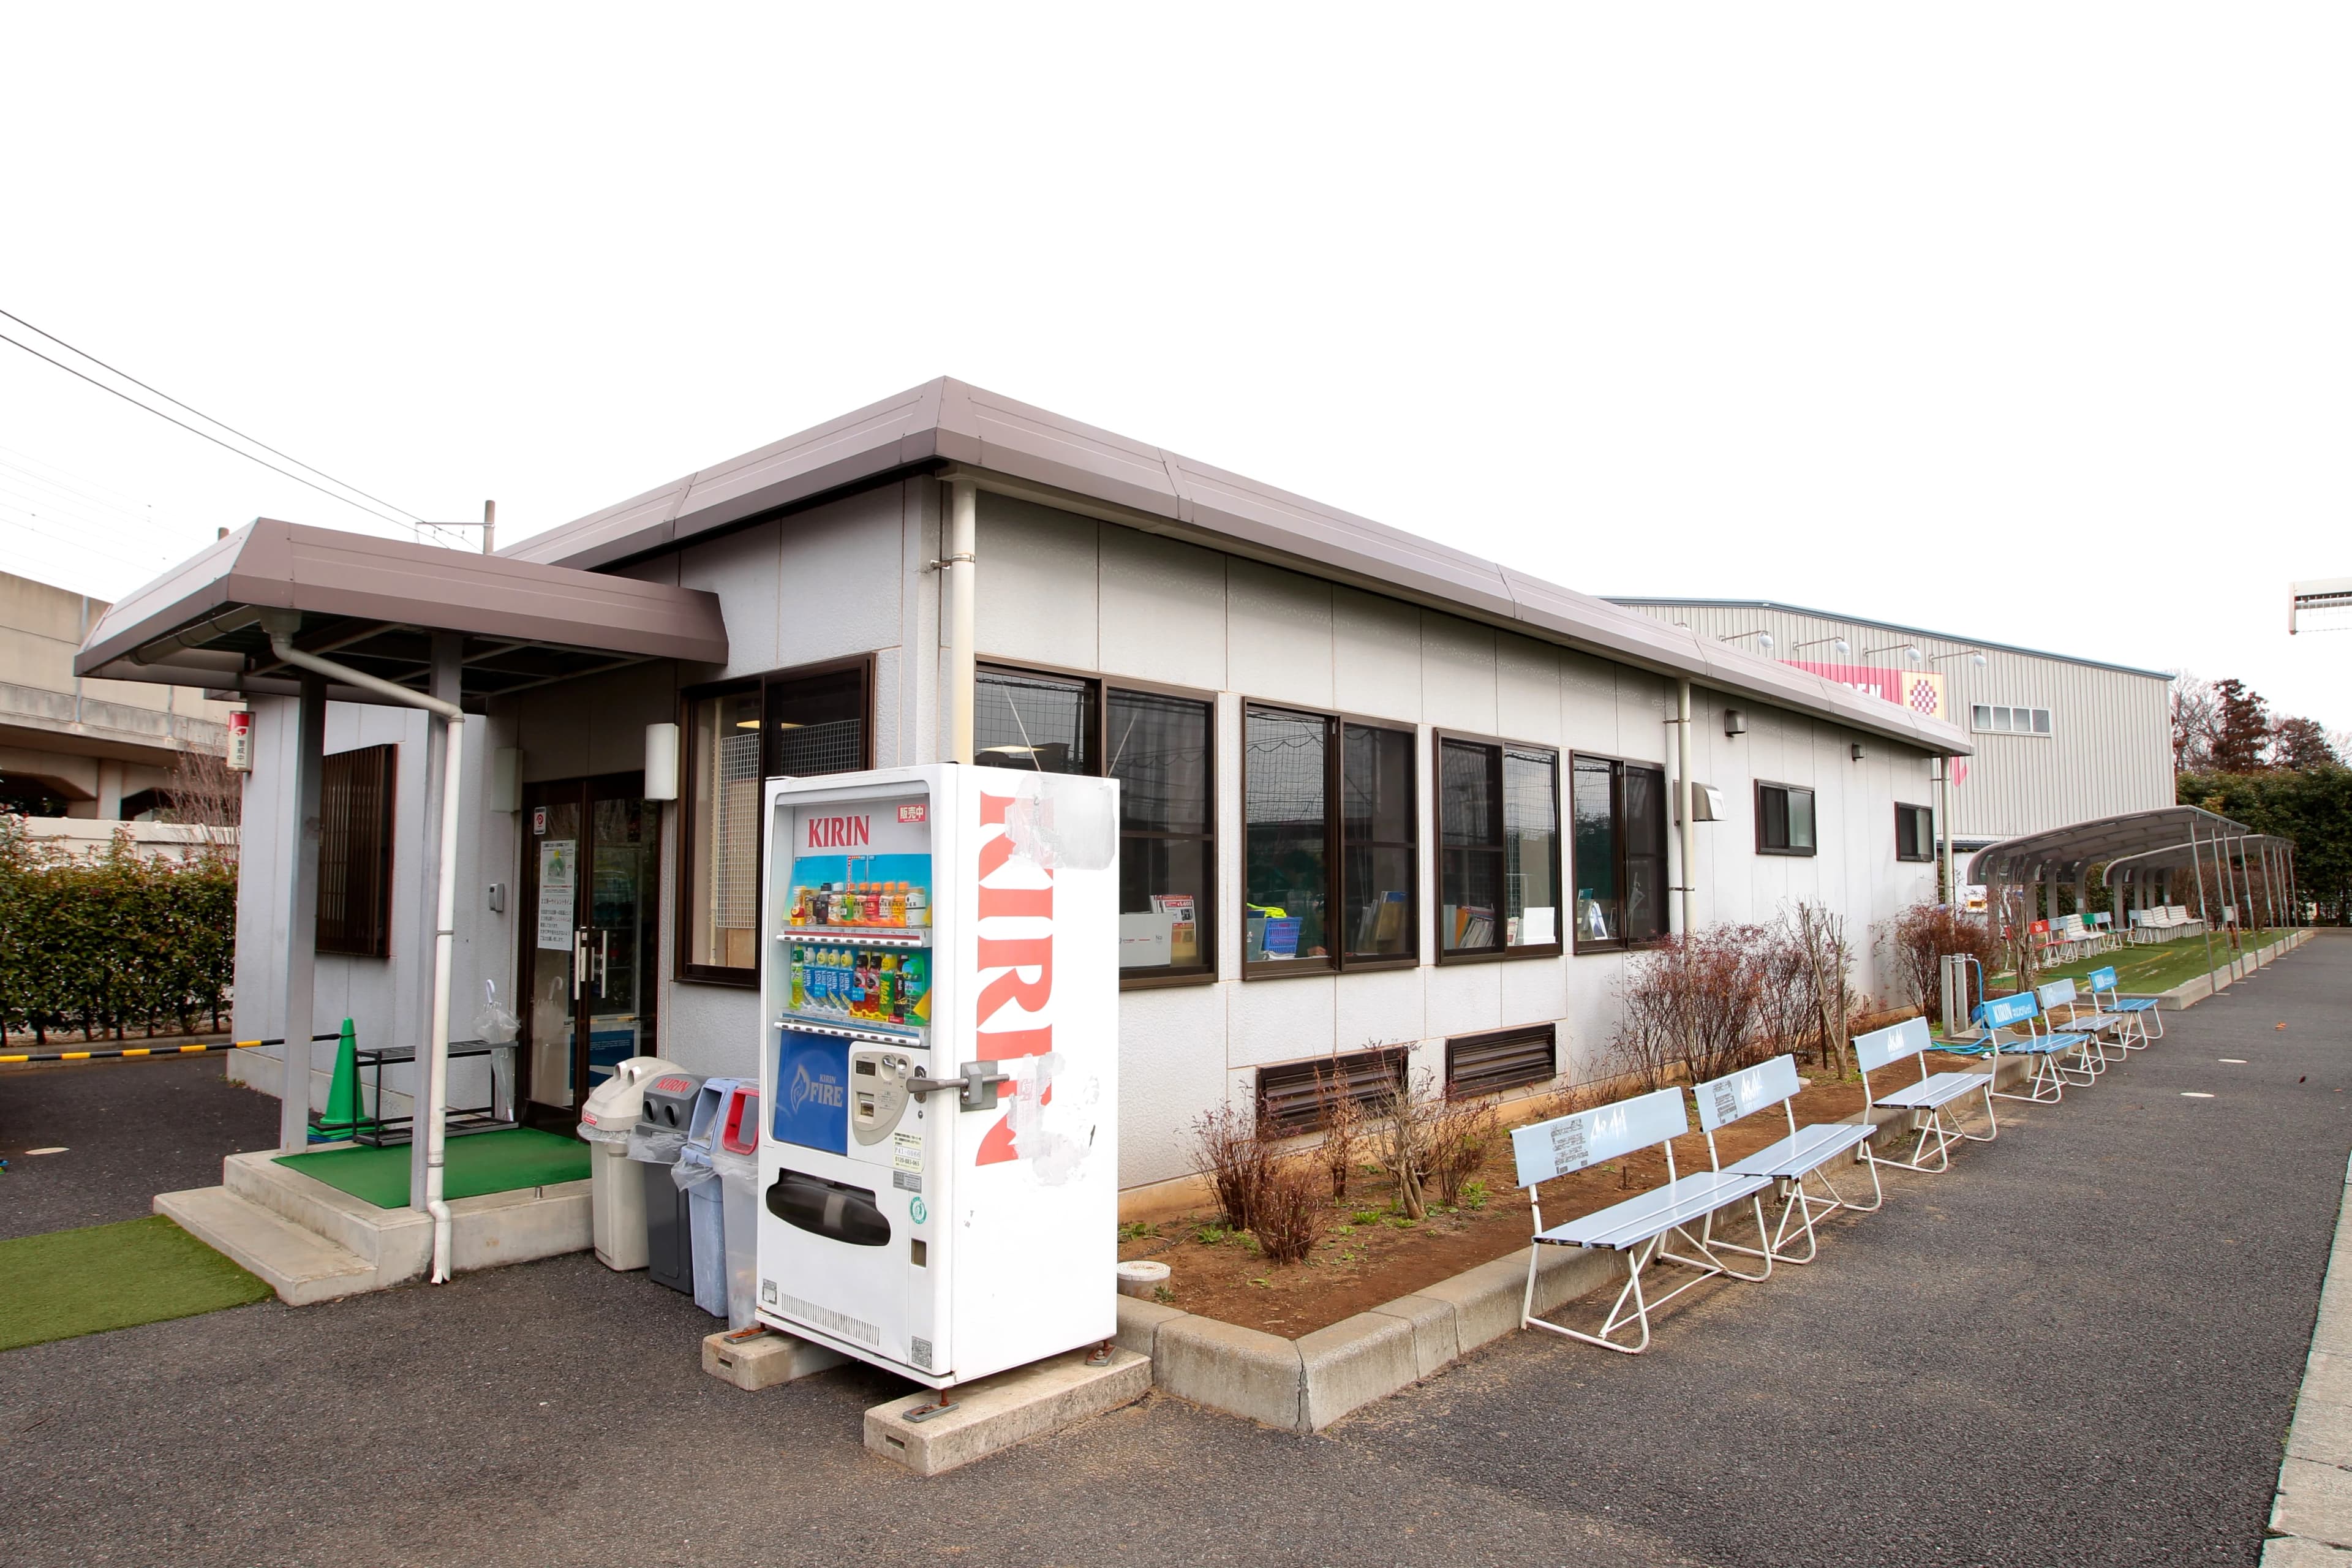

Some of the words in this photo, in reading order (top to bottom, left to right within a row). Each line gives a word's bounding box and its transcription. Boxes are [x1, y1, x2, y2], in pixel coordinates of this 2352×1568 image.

[900, 805, 924, 820] 販売中
[808, 815, 870, 848] KIRIN
[1992, 1002, 2013, 1023] KIRIN
[656, 1077, 692, 1093] KIRIN
[820, 1074, 836, 1084] KIRIN
[809, 1082, 843, 1107] FIRE
